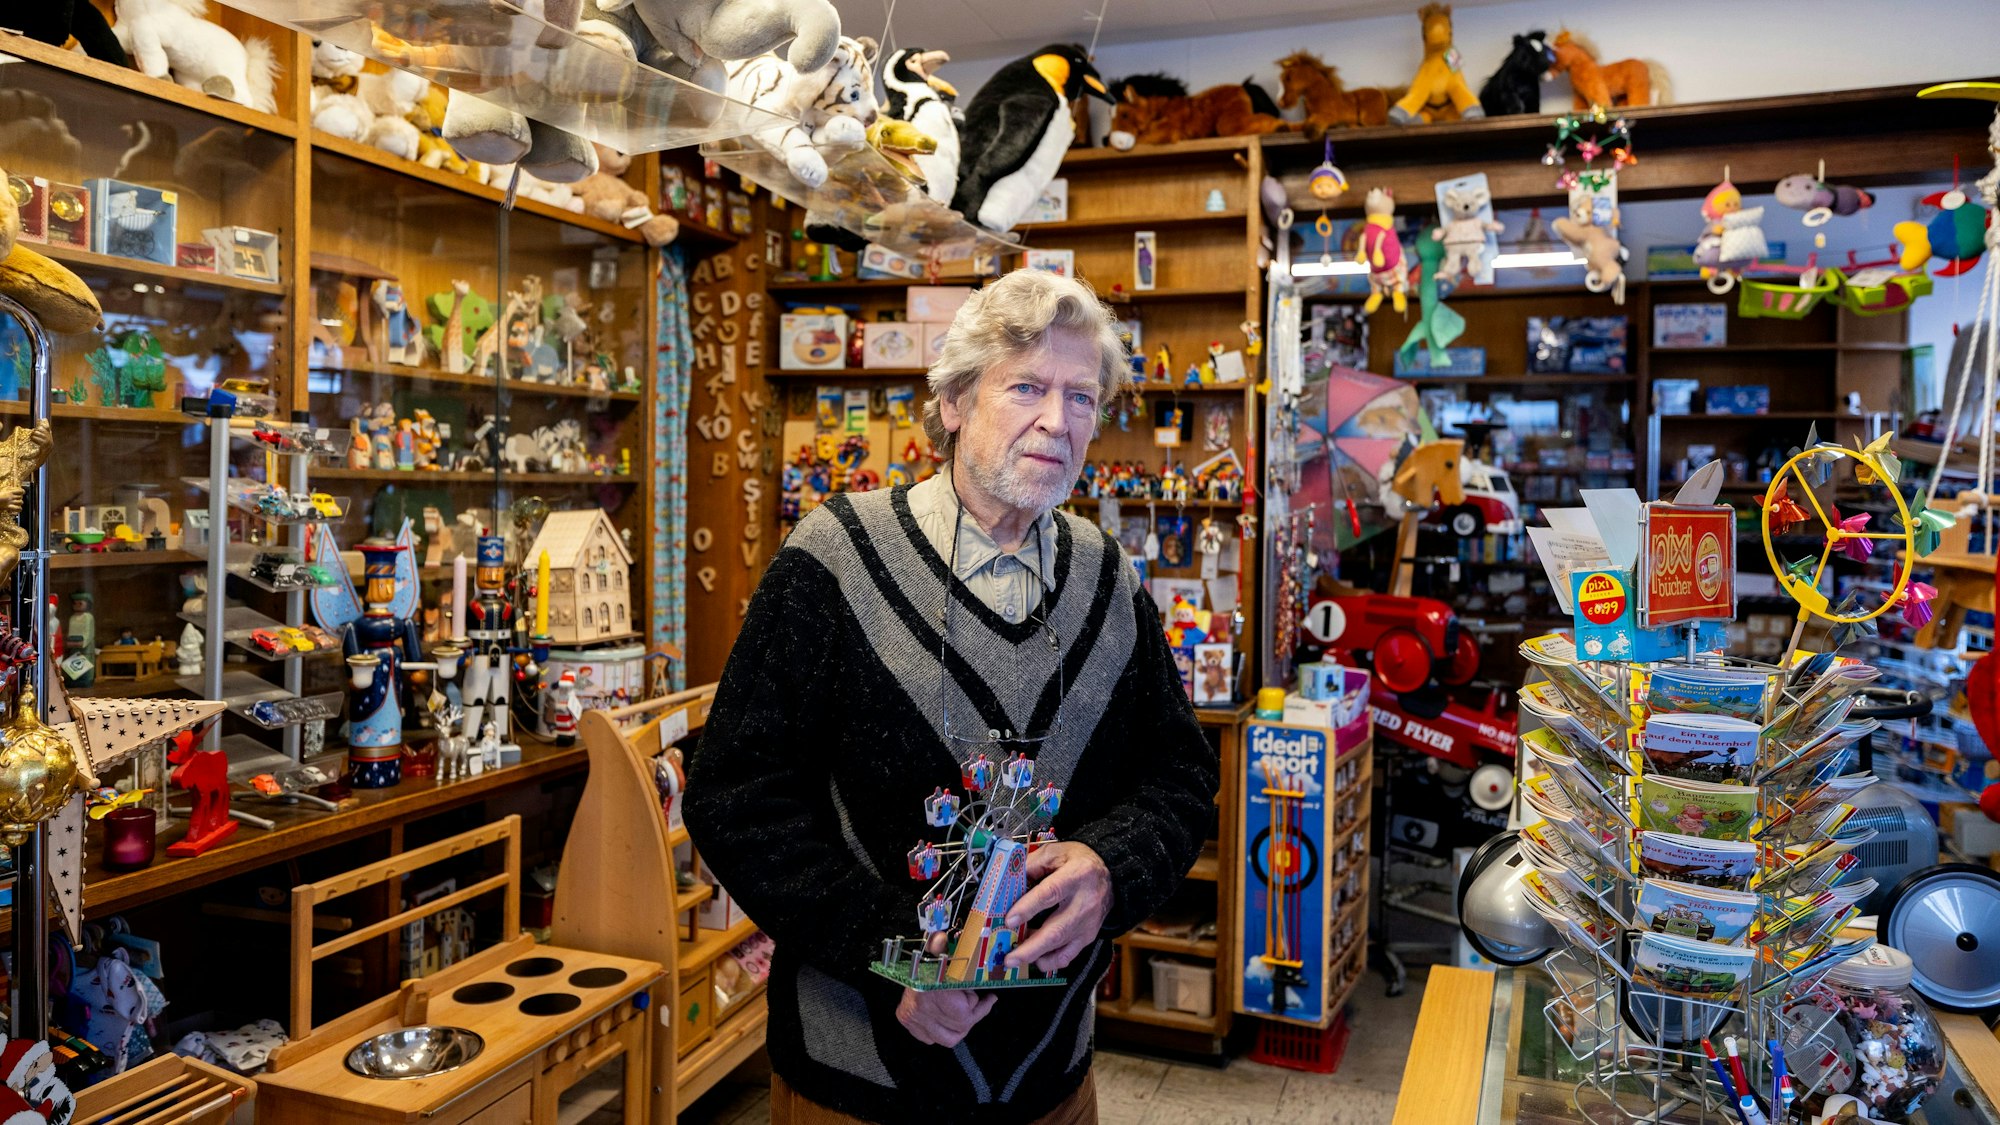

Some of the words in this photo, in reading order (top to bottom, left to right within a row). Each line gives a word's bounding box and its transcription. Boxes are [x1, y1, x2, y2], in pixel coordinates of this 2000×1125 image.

[1588, 578, 1610, 593] pixi
[1657, 576, 1692, 597] bücher
[1321, 605, 1332, 638] 1
[1668, 686, 1721, 696] Bauernhof
[1253, 726, 1307, 757] ideal
[1404, 720, 1454, 752] FLYER
[1668, 737, 1692, 745] dem
[1695, 739, 1752, 747] Bauernhof
[1665, 851, 1688, 860] dem
[1688, 902, 1737, 913] TRAKTOR
[1644, 941, 1671, 954] Große
[1673, 950, 1719, 961] Fahrzeuge
[1698, 959, 1745, 967] Bauernhof
